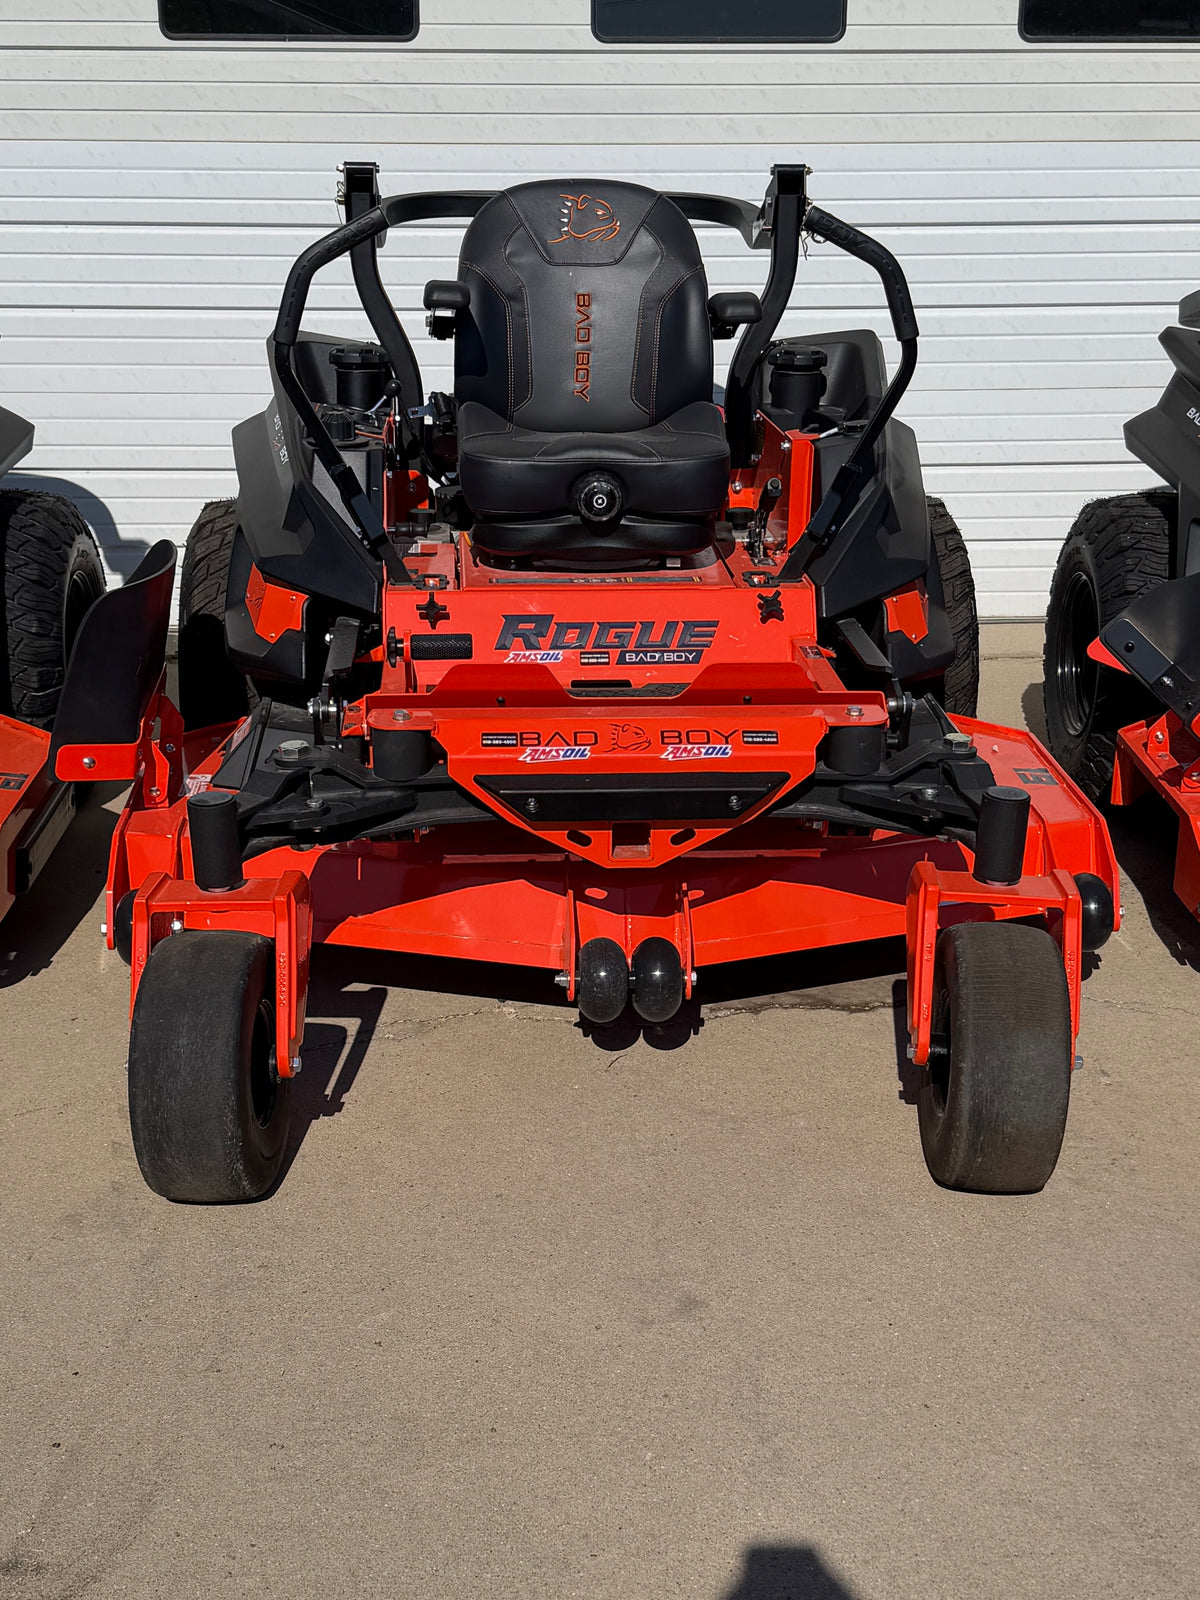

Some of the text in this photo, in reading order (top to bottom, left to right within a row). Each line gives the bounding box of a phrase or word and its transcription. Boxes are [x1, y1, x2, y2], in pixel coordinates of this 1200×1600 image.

[574, 292, 592, 402] BAD BOY
[494, 614, 720, 650] ROGUE
[505, 651, 563, 663] AMSOIL
[625, 652, 696, 662] BAD BOY
[519, 731, 598, 746] BAD
[660, 729, 739, 745] BOY
[520, 747, 590, 761] AMSOIL
[663, 745, 731, 760] AMSOIL
